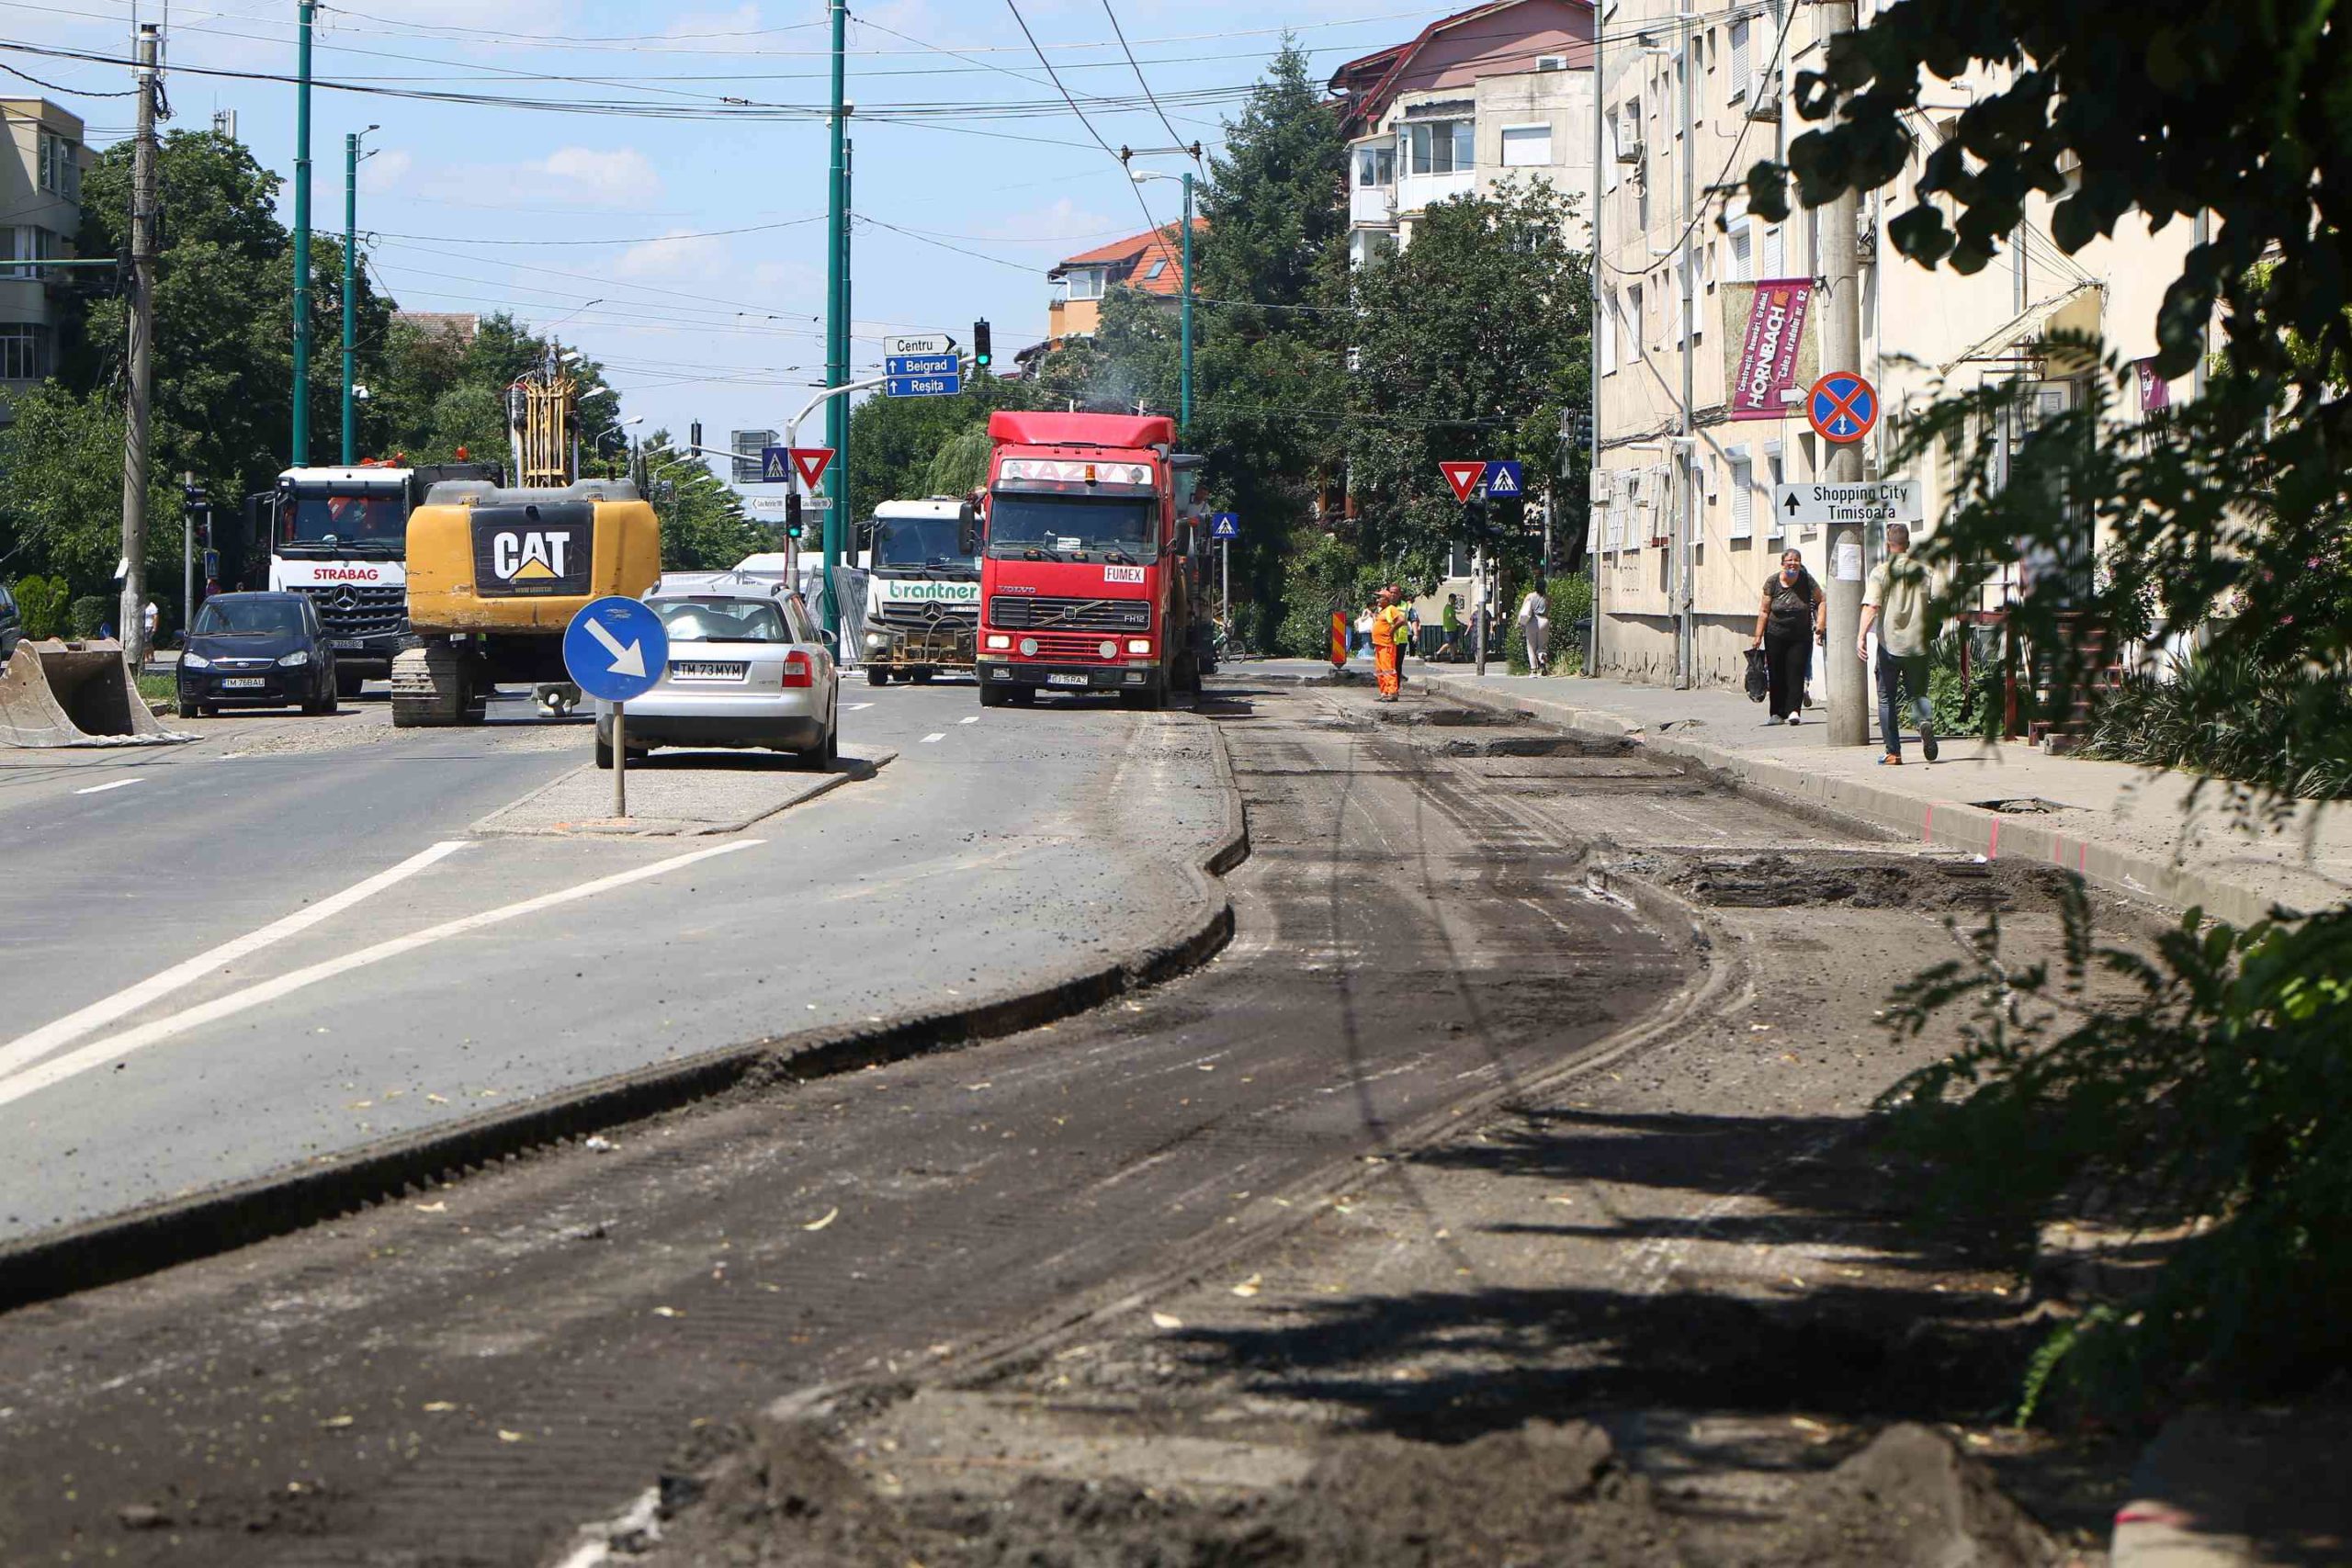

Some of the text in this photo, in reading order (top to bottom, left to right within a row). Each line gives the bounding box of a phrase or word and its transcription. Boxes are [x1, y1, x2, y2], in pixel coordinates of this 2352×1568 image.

[1779, 289, 1808, 378] Calea Aradului nr. 62
[897, 339, 933, 353] Centru
[1747, 306, 1786, 408] HORNBACH
[906, 358, 947, 374] Belgrad
[1814, 485, 1908, 504] Shopping City
[493, 532, 570, 580] CAT
[313, 569, 379, 581] STRABAG
[1106, 567, 1141, 581] FUMEX
[889, 581, 978, 599] brantner
[997, 585, 1036, 593] VOLVO
[1124, 615, 1146, 623] FH12
[681, 663, 695, 676] TM
